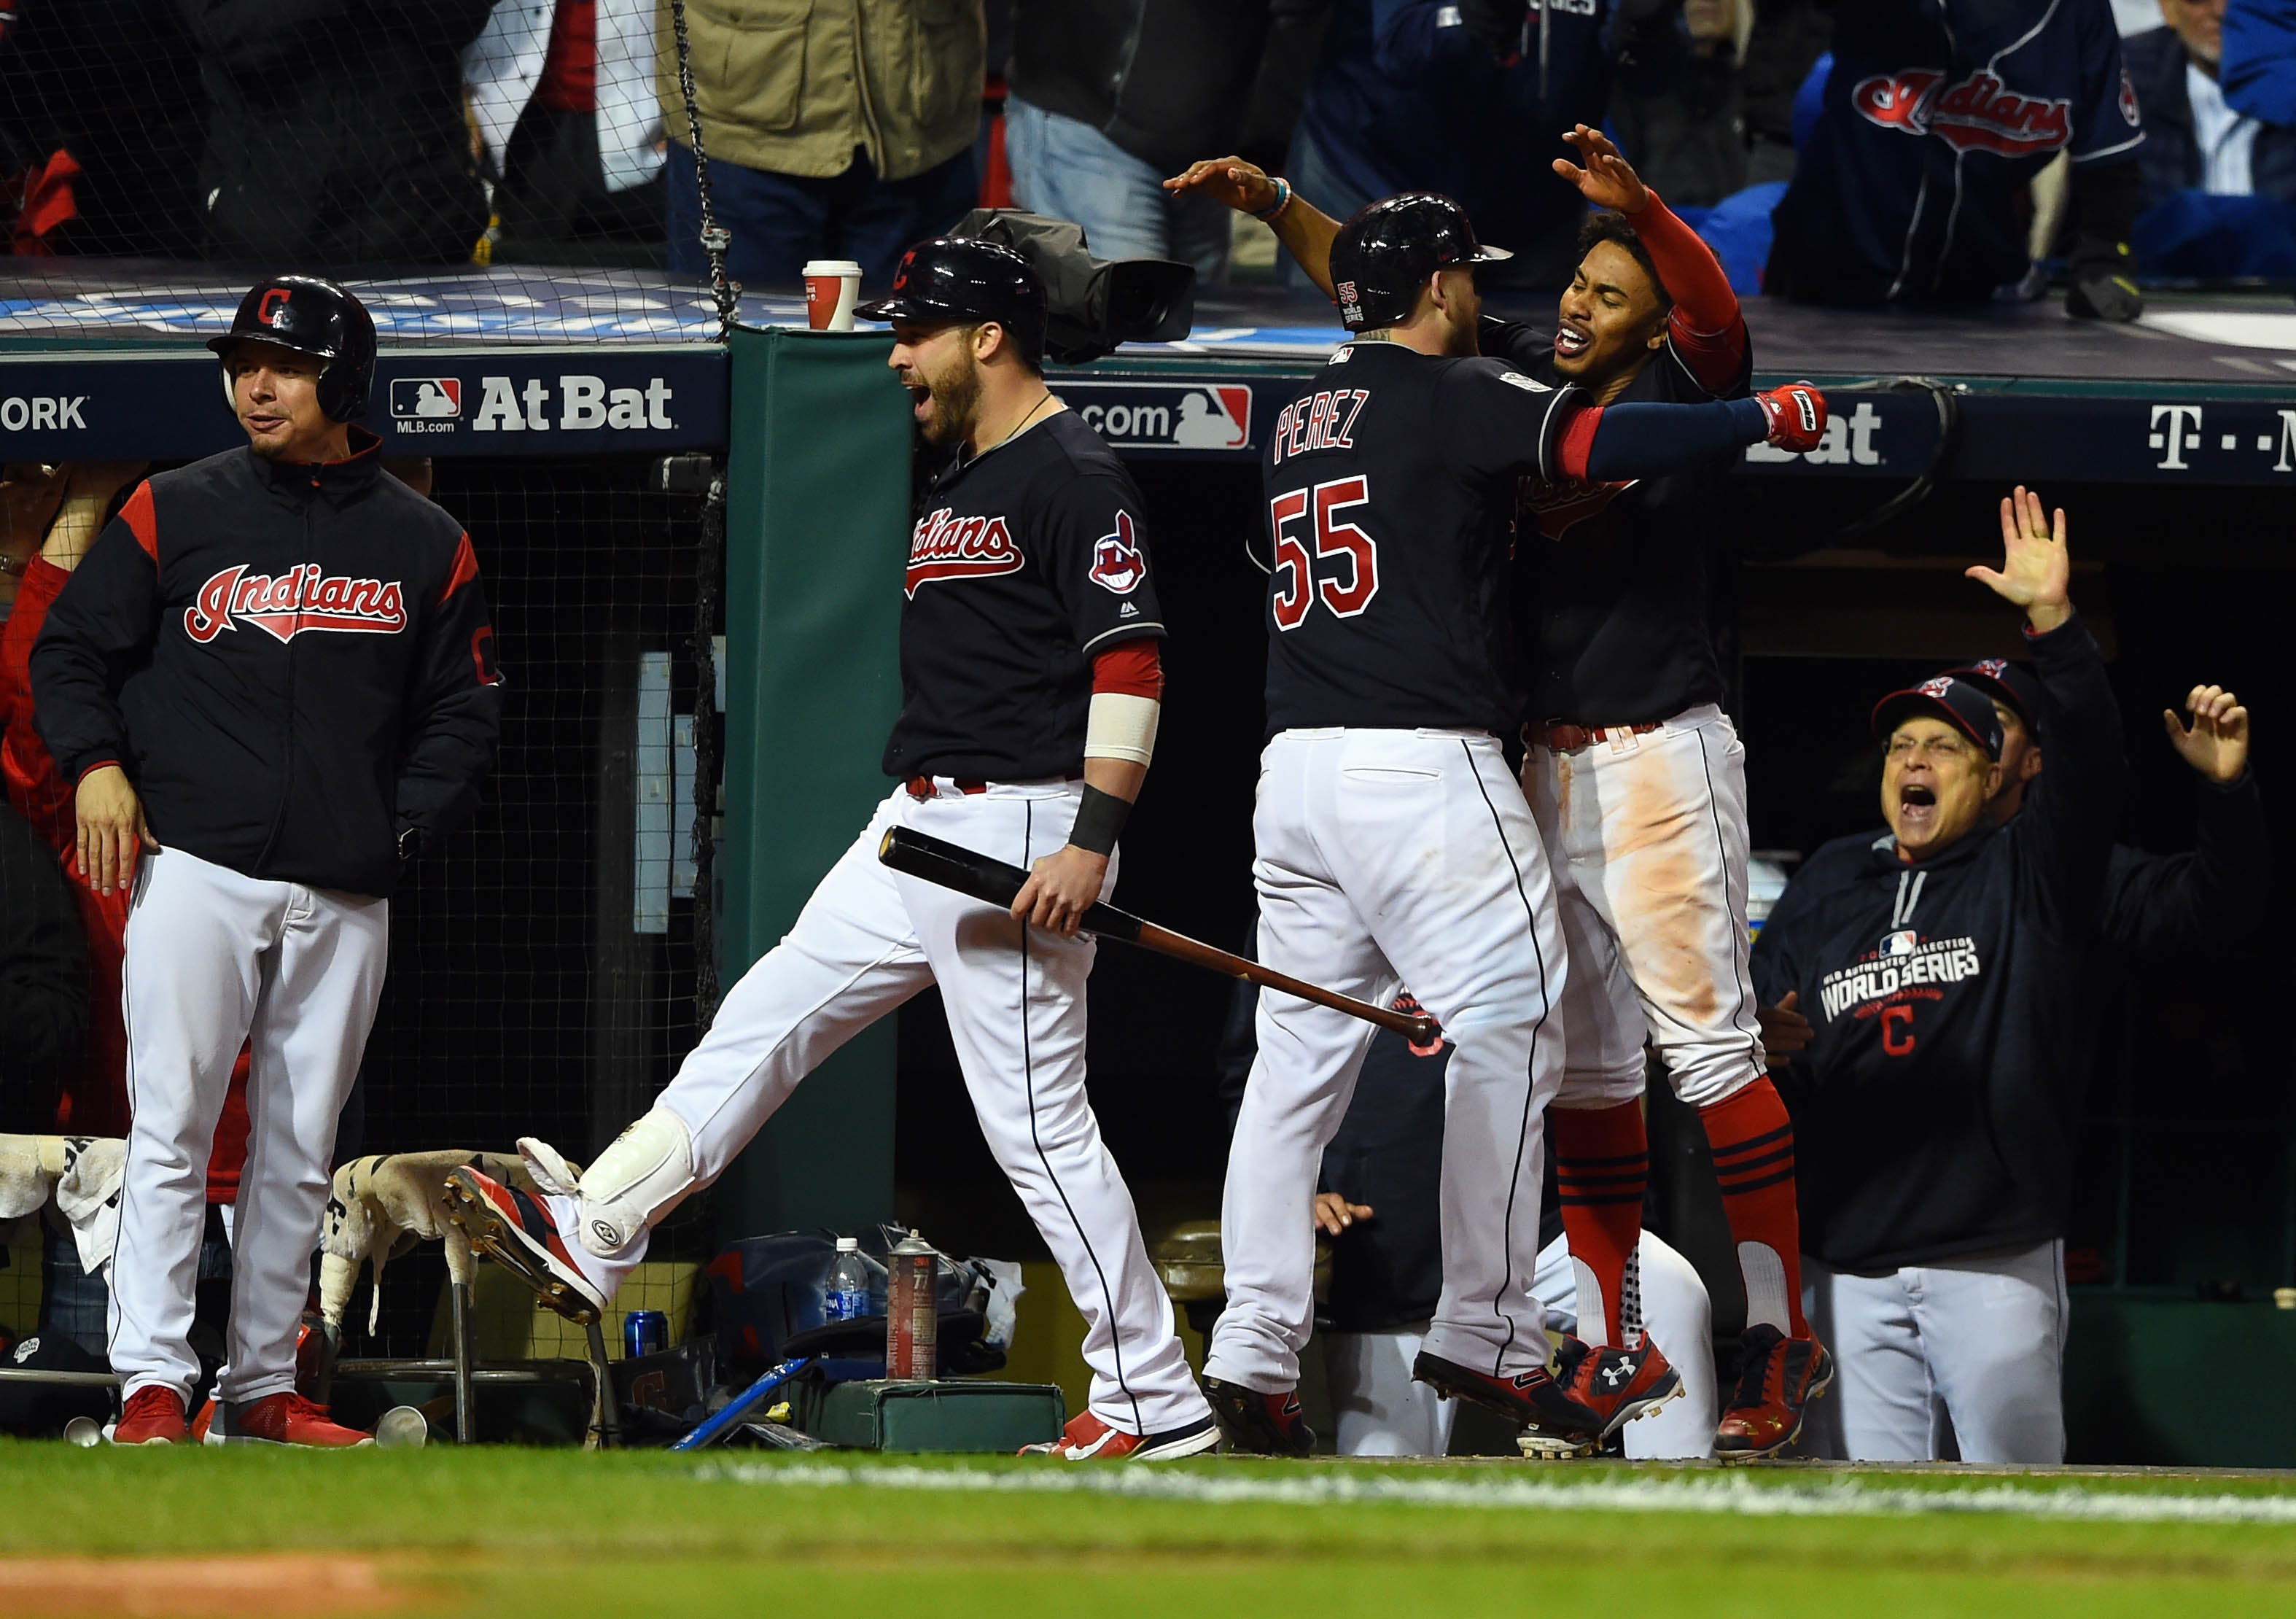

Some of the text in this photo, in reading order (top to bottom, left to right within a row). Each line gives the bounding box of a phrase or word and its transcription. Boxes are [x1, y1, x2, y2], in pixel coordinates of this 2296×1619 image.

[258, 288, 290, 325] C
[1337, 281, 1358, 303] 55
[1343, 306, 1362, 315] WORLD
[1345, 313, 1364, 324] SERIES
[1, 397, 87, 430] ORK
[473, 376, 672, 431] At Bat
[1081, 405, 1170, 436] com
[397, 421, 454, 433] MLB.com
[1274, 389, 1370, 466] PEREZ
[908, 508, 1025, 580] dians
[1271, 474, 1379, 632] 55
[184, 564, 408, 645] Indians
[1821, 949, 1980, 1022] WORLD SERIES
[1880, 1004, 1915, 1055] C
[914, 1274, 928, 1289] 77
